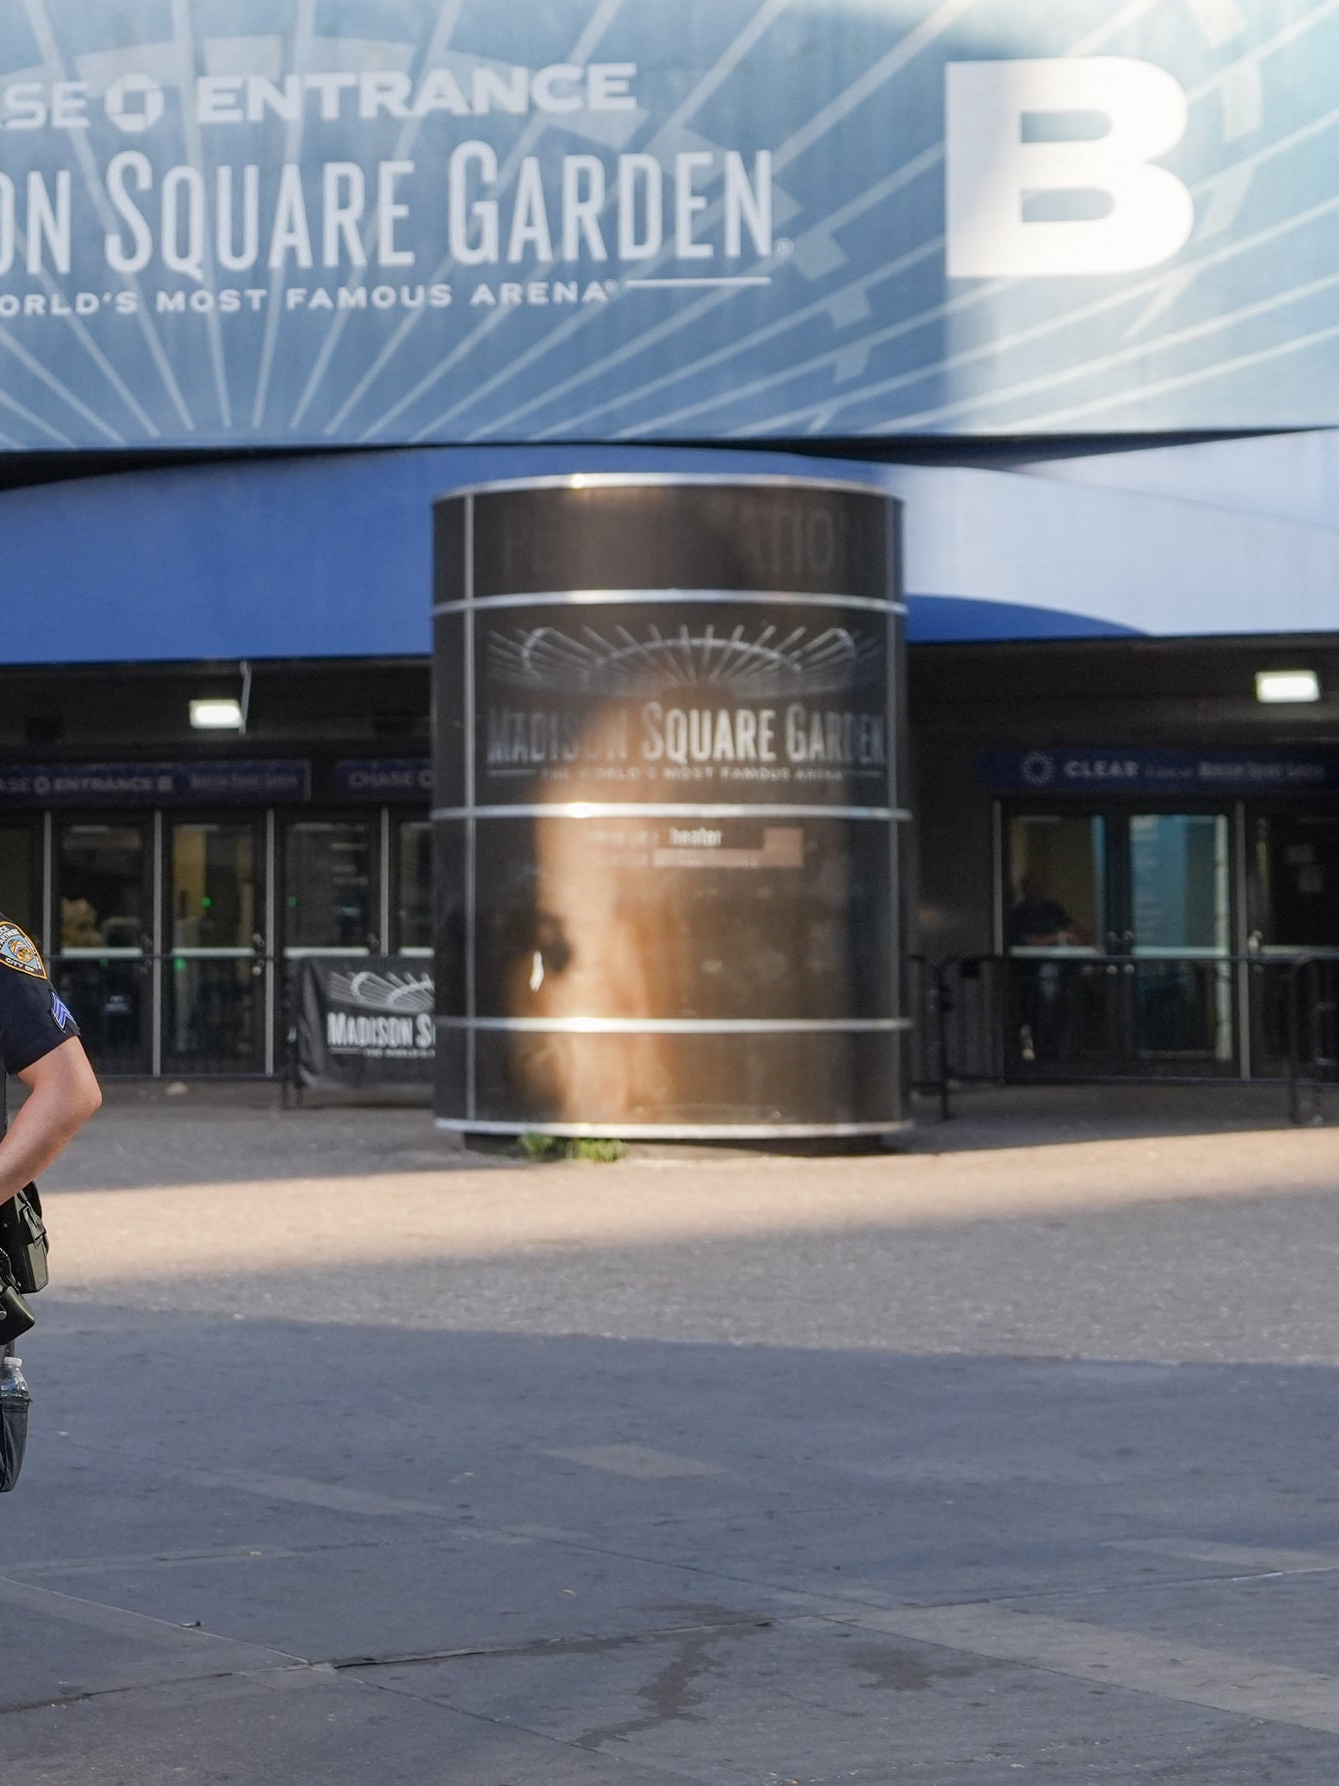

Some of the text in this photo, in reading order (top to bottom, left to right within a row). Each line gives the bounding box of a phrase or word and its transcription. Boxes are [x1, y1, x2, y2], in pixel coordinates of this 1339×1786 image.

[197, 62, 637, 124] ENTRANCE
[946, 56, 1194, 278] B
[105, 150, 416, 281] SQUARE
[450, 140, 773, 266] GARDEN
[156, 287, 267, 313] MOST
[287, 283, 453, 311] FAMOUS
[471, 281, 610, 306] ARENA
[641, 701, 777, 766] SQUARE
[580, 767, 658, 780] WORLDS
[665, 766, 714, 780] MOST
[720, 766, 791, 780] FAMOUS
[1064, 760, 1140, 778] CLEAR
[327, 1011, 436, 1049] MADISON S
